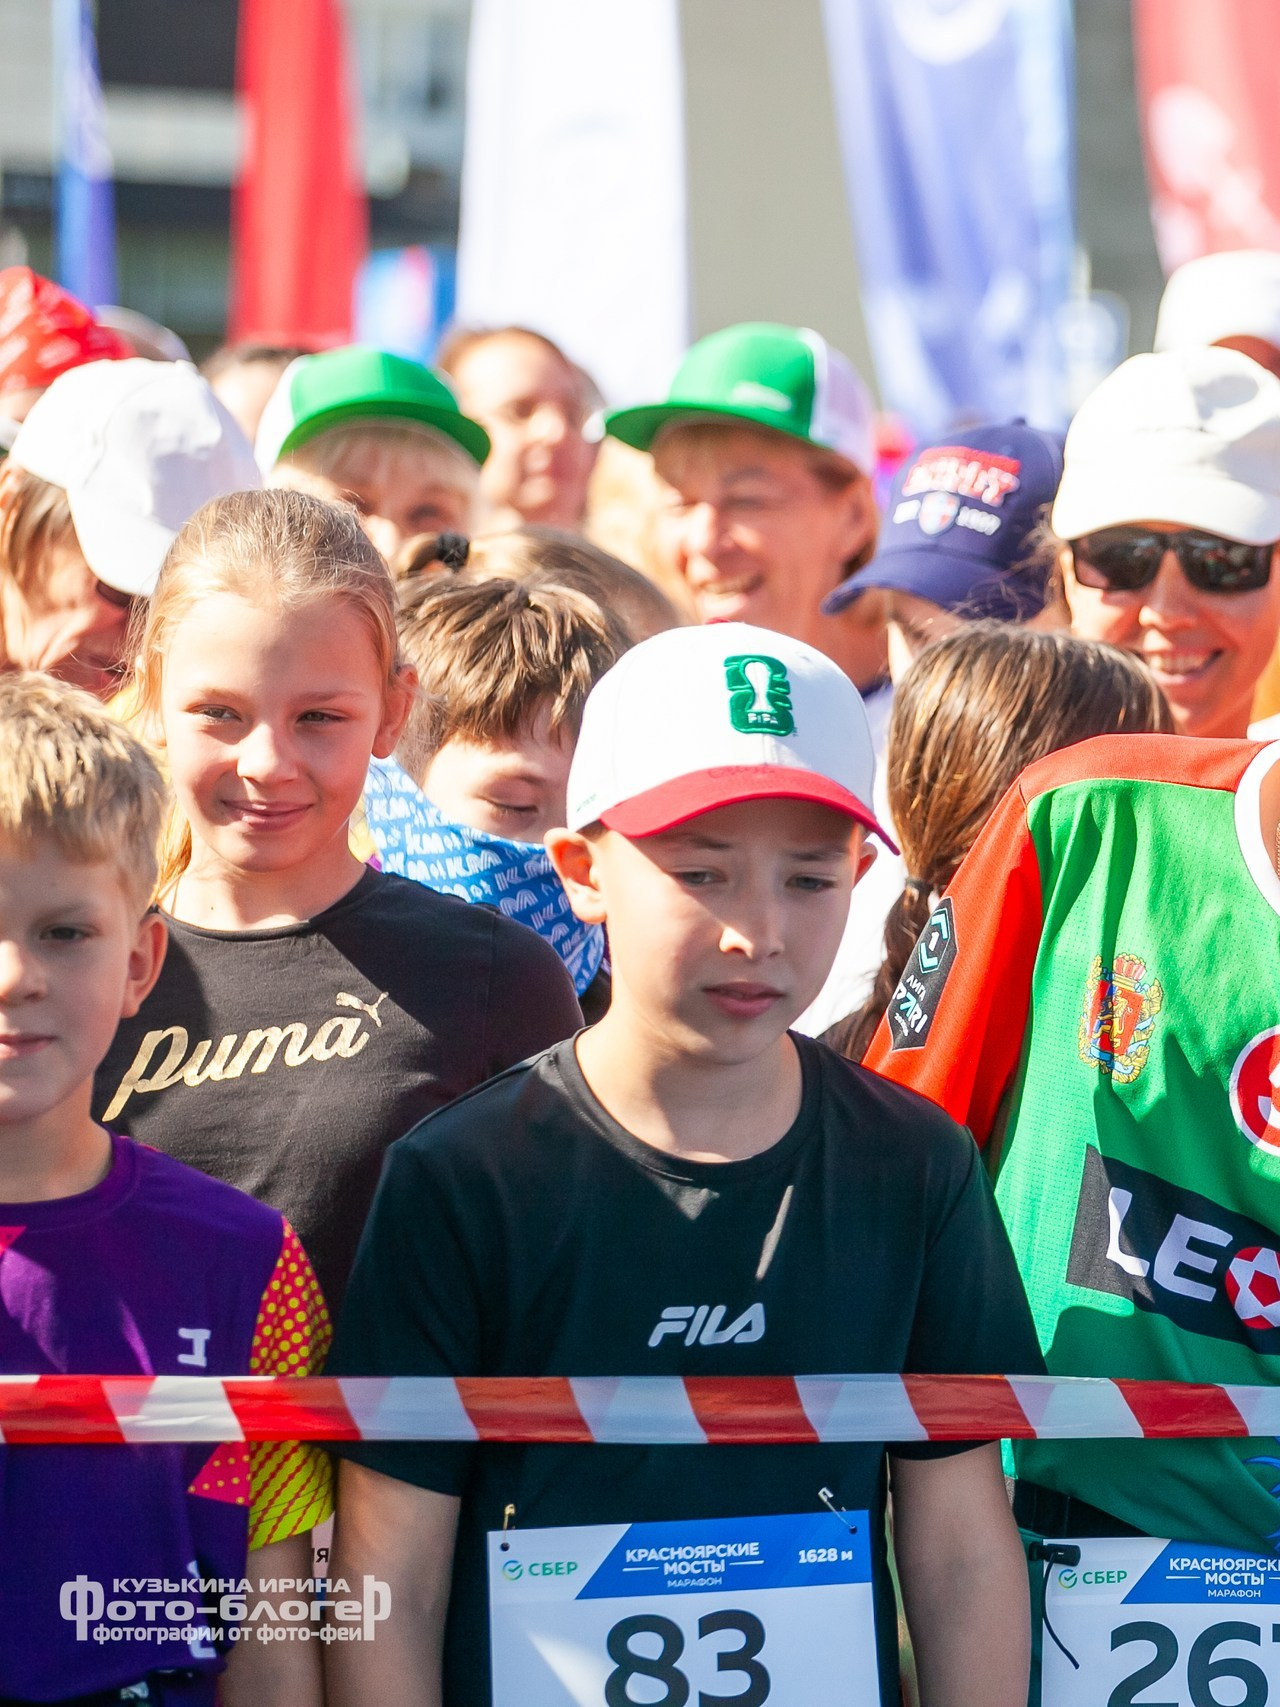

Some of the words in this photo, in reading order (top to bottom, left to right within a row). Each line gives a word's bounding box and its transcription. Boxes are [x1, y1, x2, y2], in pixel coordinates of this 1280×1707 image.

[747, 713, 778, 724] FIFA
[647, 1302, 766, 1348] FILA
[626, 1541, 760, 1563] КРАСНОЯРСКИЕ
[799, 1547, 838, 1564] 1628
[528, 1560, 578, 1577] СБЕР
[663, 1558, 726, 1576] МОСТЫ
[667, 1577, 722, 1588] МАРАФОН
[1082, 1570, 1128, 1585] СБЕР
[1205, 1572, 1265, 1586] МОСТЫ
[1207, 1588, 1261, 1599] МАРАФОН
[604, 1608, 771, 1707] 83
